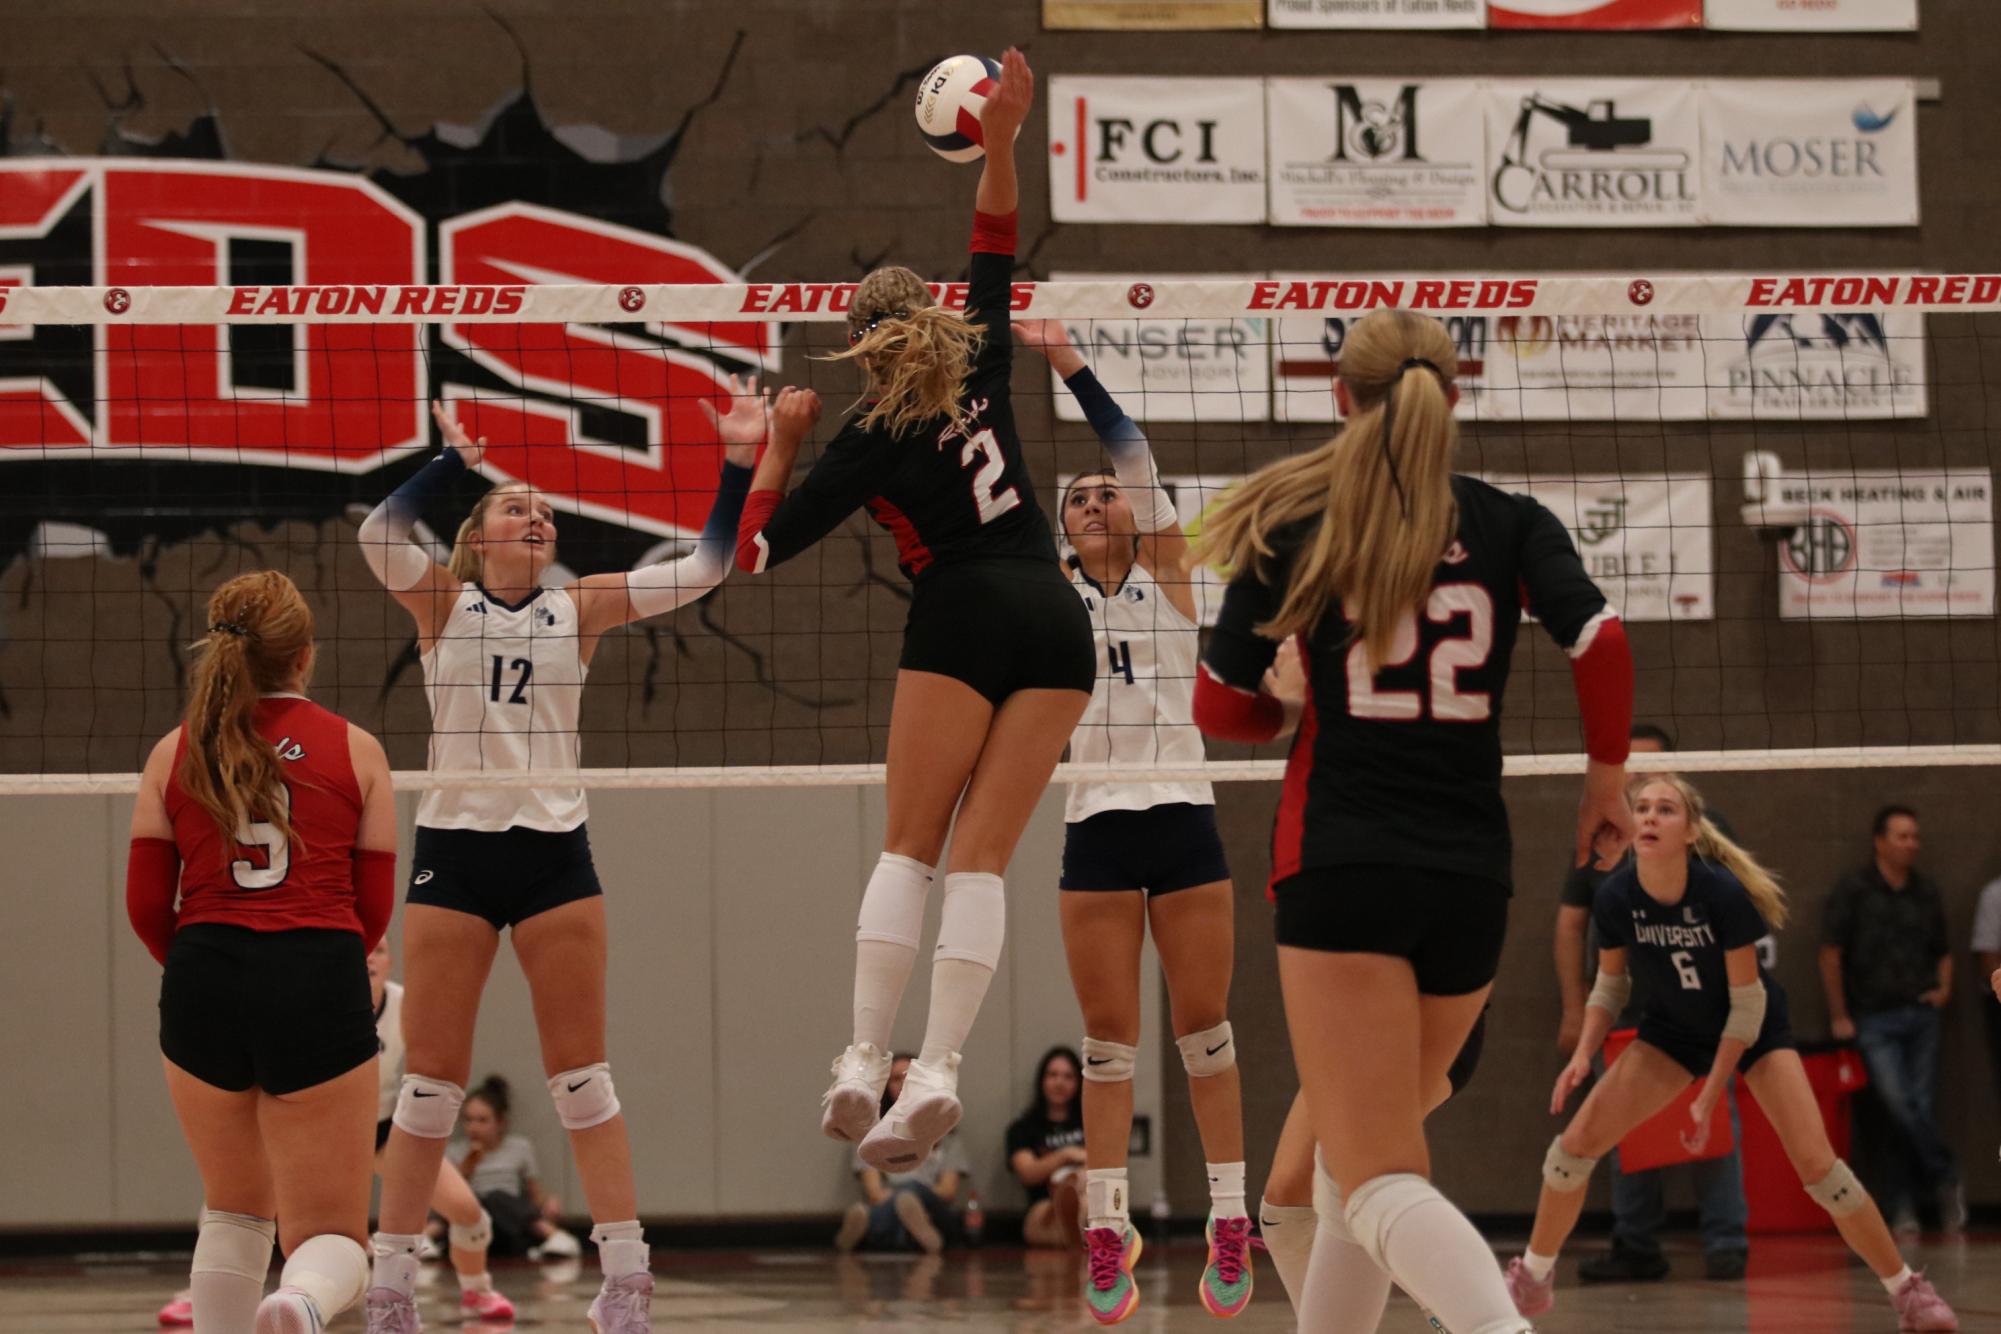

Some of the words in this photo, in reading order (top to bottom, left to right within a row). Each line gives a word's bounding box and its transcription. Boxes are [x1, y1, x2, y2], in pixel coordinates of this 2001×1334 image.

[1096, 118, 1218, 164] FCI
[1721, 137, 1884, 177] MOSER
[1492, 164, 1696, 214] CARROLL
[226, 287, 389, 315] EATON
[391, 286, 527, 315] REDS
[738, 284, 860, 312] EATO
[1246, 281, 1415, 310] EATON
[1409, 280, 1538, 309] REDS
[1745, 277, 1900, 306] EATON
[1904, 276, 2001, 304] RED
[1561, 333, 1694, 350] MARKET
[1729, 366, 1915, 395] PINNACLE
[961, 427, 1021, 525] 2
[1781, 488, 1834, 501] BECK
[1840, 488, 1926, 501] HEATING
[1953, 488, 1985, 501] AIR
[1108, 640, 1134, 685] 4
[1342, 582, 1495, 722] 22
[490, 655, 533, 705] 12
[231, 782, 291, 890] 9
[1634, 921, 1716, 948] UNIVERSITY
[1670, 950, 1702, 990] 6
